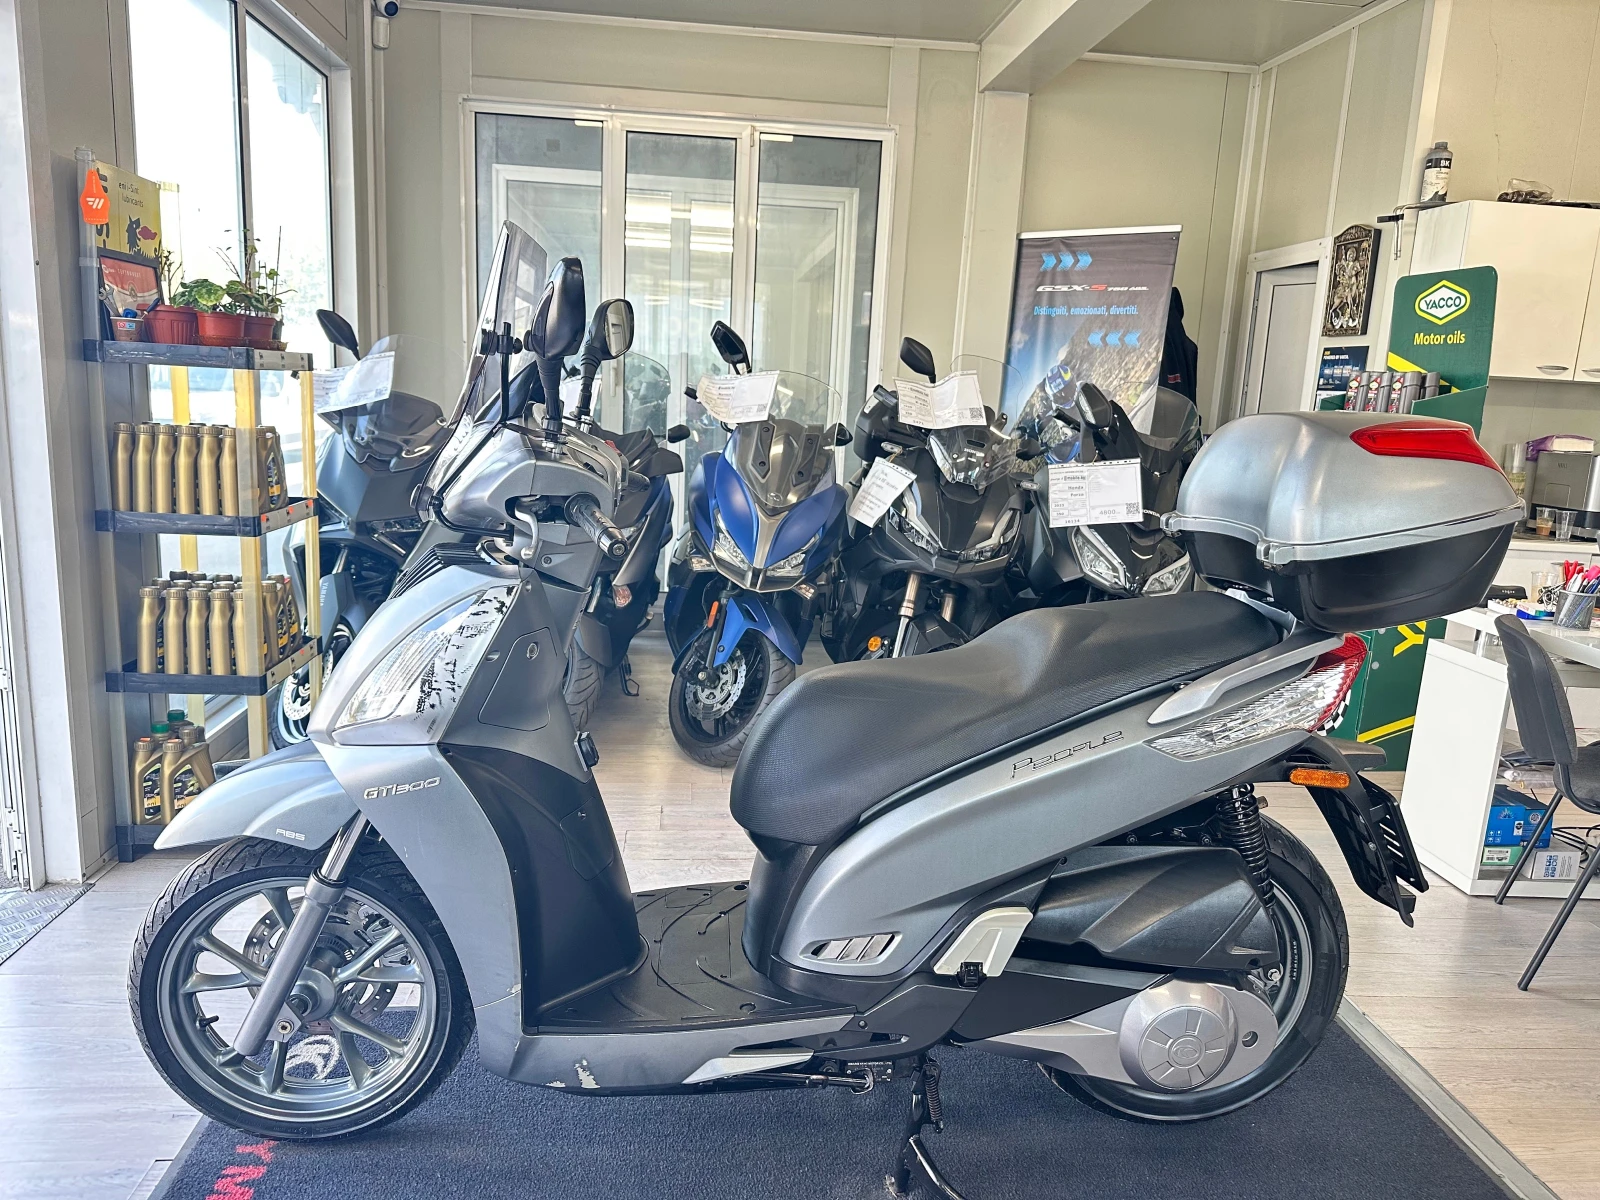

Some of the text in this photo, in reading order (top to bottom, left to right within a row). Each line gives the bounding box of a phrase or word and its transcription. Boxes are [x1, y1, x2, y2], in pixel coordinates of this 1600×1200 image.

[121, 193, 144, 208] lubricants
[1424, 296, 1462, 310] YACCO
[1033, 304, 1139, 317] Distinguiti, emozionati, divertiti.
[1413, 330, 1466, 346] Motor oils
[1143, 508, 1160, 518] ONDA
[275, 828, 306, 841] ABS
